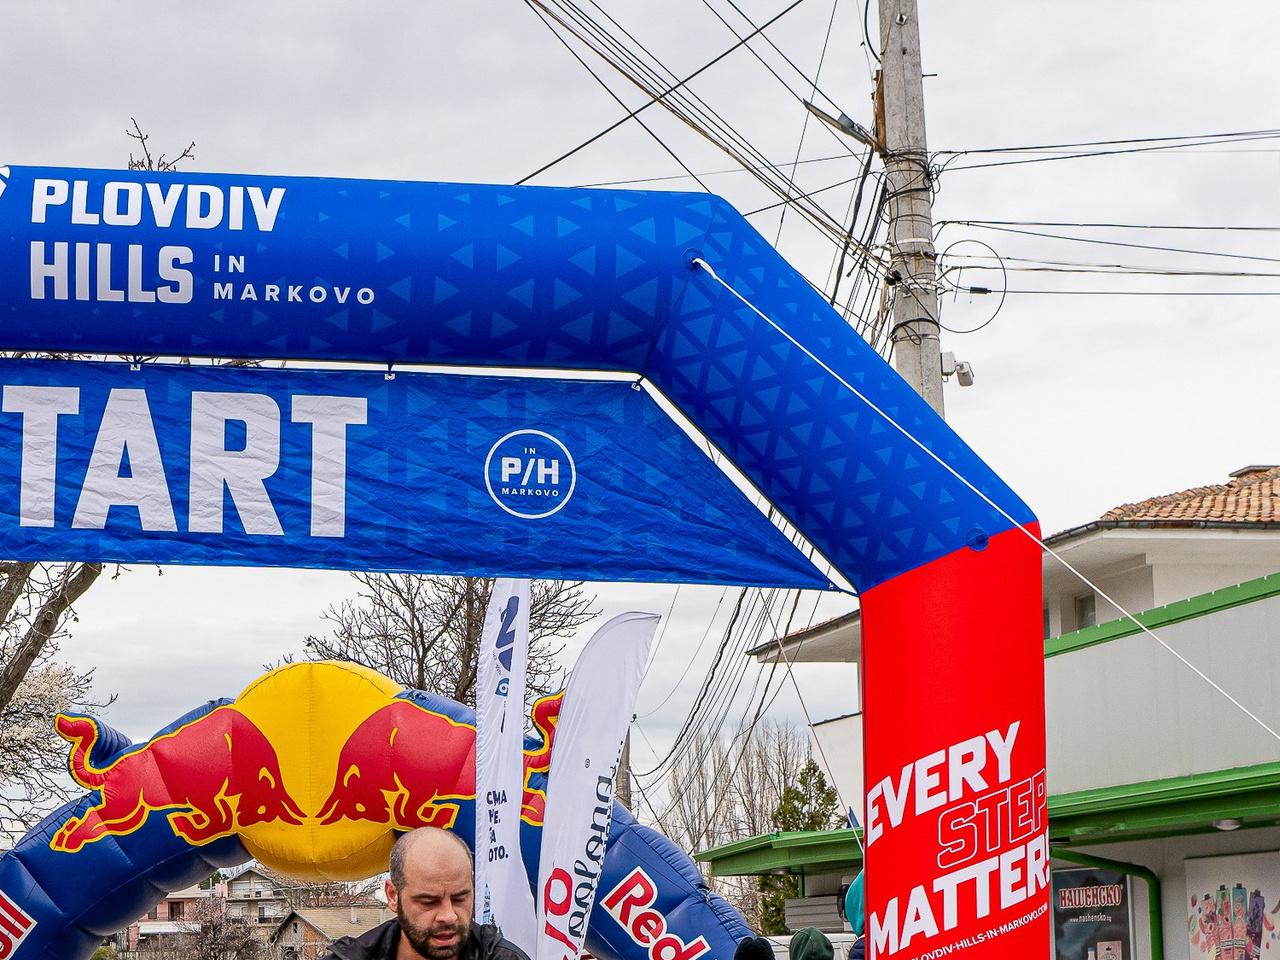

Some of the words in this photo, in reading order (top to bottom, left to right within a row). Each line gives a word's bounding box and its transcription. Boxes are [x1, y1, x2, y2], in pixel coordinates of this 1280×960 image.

[31, 178, 286, 231] PLOVDIV
[31, 241, 194, 303] HILLS
[214, 255, 245, 273] IN
[213, 283, 375, 304] MARKOVO
[501, 457, 559, 486] P/H
[501, 487, 559, 497] MARKOVO
[868, 720, 1020, 848] EVERY
[937, 768, 1046, 869] STEP
[1059, 885, 1122, 909] НАШЕНСКО
